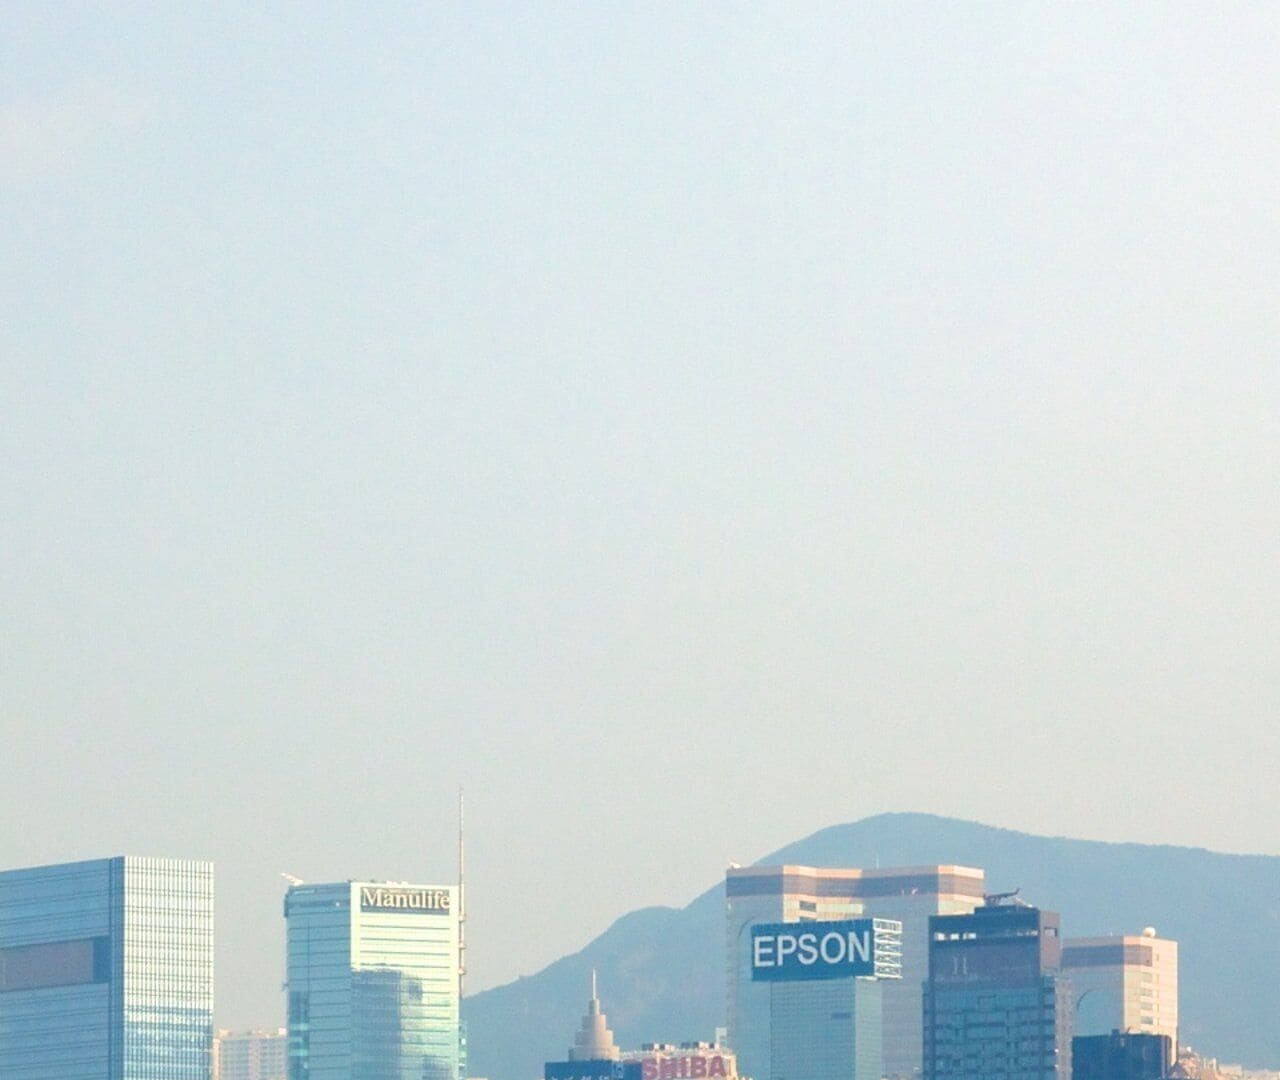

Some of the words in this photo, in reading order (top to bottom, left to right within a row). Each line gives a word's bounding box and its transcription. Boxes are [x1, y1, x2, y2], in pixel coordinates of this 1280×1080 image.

[362, 887, 450, 909] Manulife
[754, 932, 870, 967] EPSON
[642, 1056, 728, 1080] SHIBA
